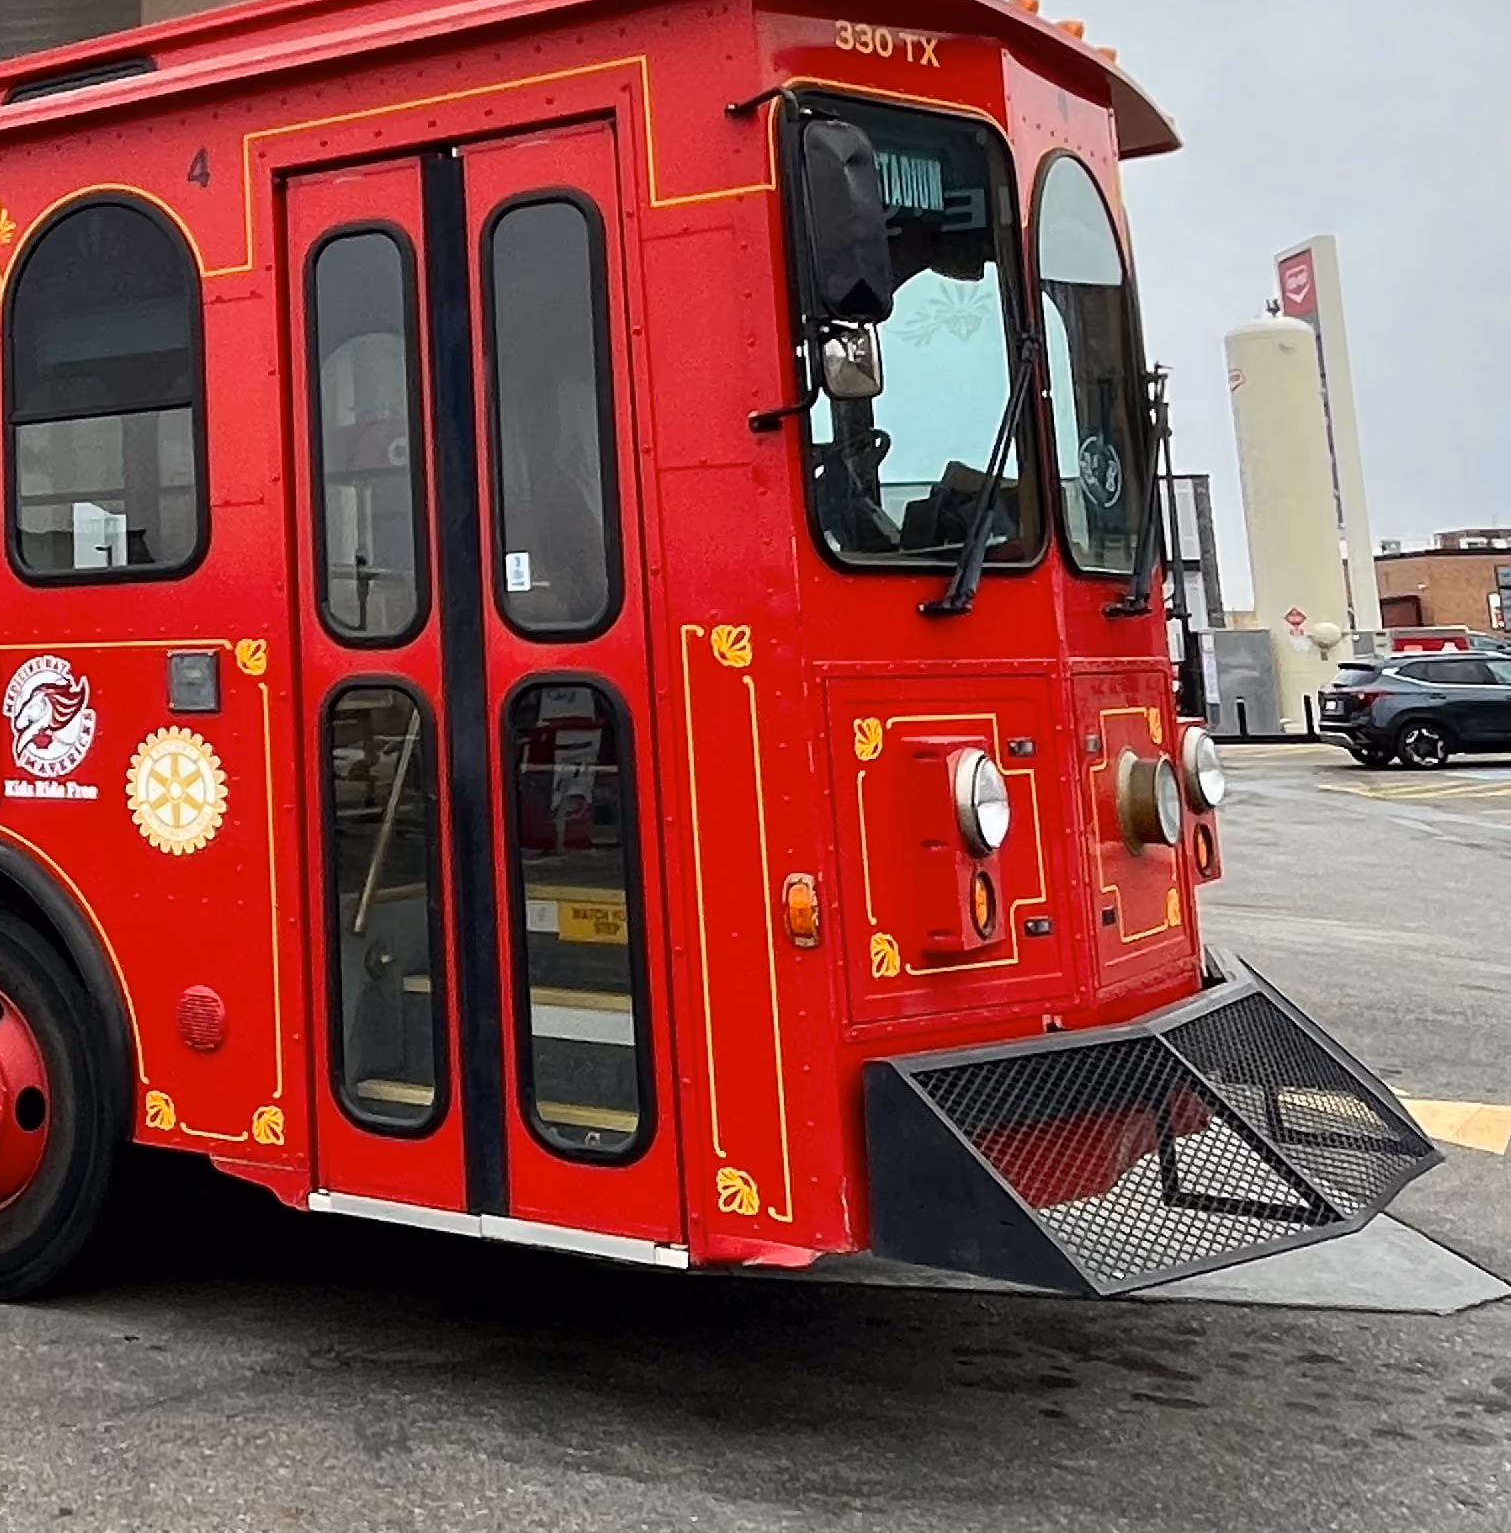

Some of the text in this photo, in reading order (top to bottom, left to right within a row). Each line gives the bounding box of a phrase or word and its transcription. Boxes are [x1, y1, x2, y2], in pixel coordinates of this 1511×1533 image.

[835, 20, 941, 68] 330 TX
[187, 146, 210, 188] 4
